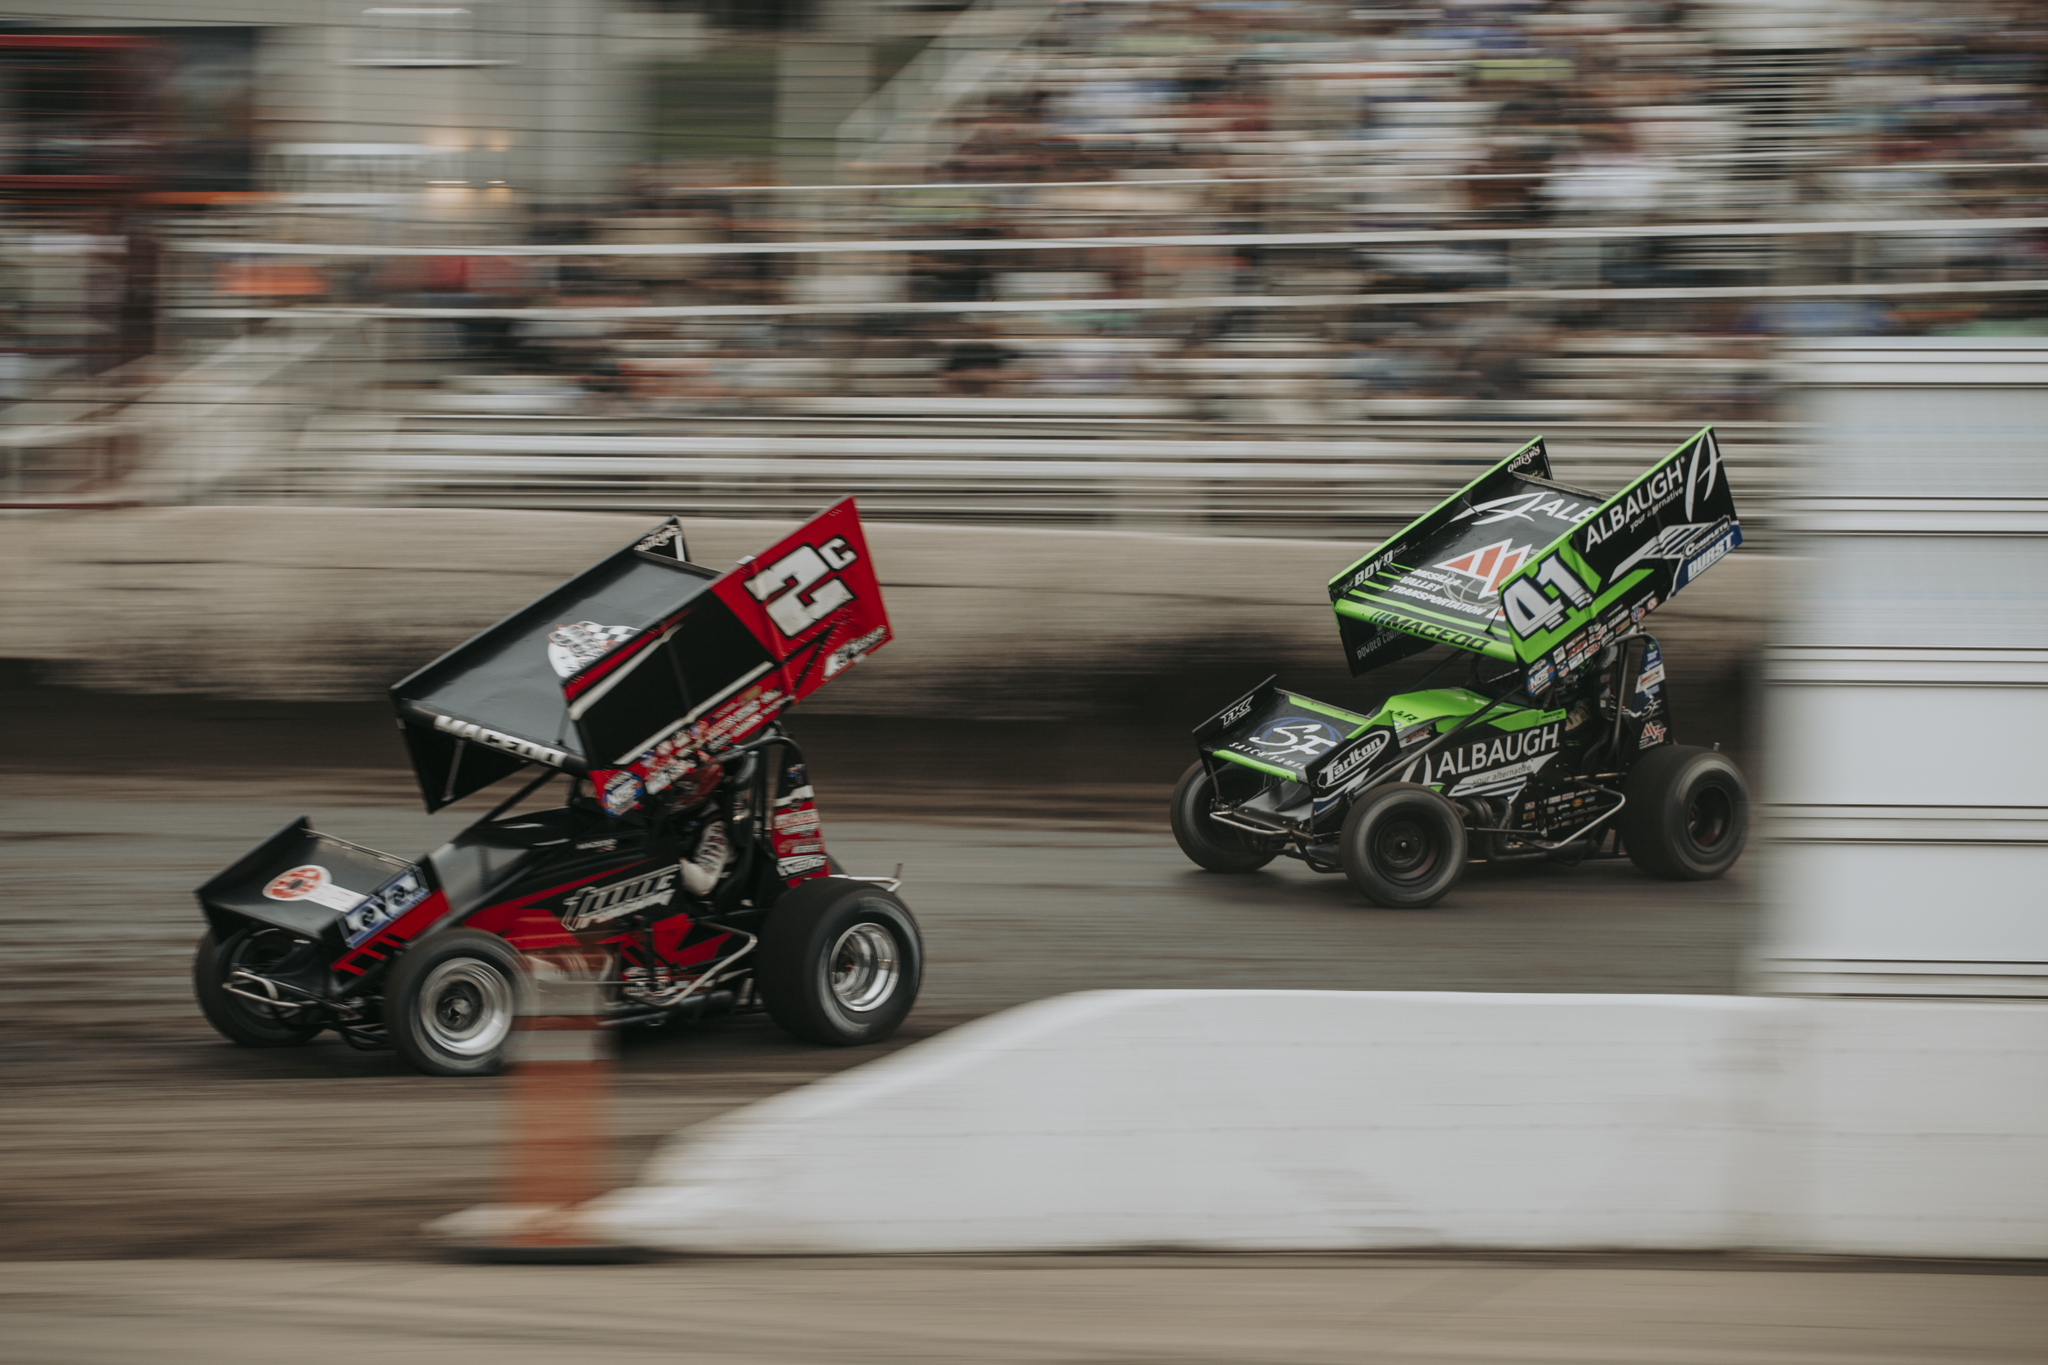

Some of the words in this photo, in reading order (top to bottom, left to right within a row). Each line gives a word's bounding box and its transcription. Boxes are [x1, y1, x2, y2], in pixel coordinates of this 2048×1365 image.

[1585, 458, 1684, 553] ALBAUGH
[1629, 513, 1646, 533] your
[1684, 520, 1729, 557] COMPLETE
[1687, 531, 1735, 581] DURST
[1354, 549, 1394, 587] BOYD
[1399, 576, 1444, 592] VALLEY
[1410, 568, 1462, 586] MESILLA
[1388, 584, 1487, 615] TRANSPORTATION
[1502, 551, 1594, 640] 41
[1385, 614, 1491, 651] MACEDO
[1530, 664, 1551, 690] NOS
[1318, 737, 1381, 788] Tarlton
[1436, 723, 1559, 779] ALBAUGH
[1492, 764, 1532, 780] alternative
